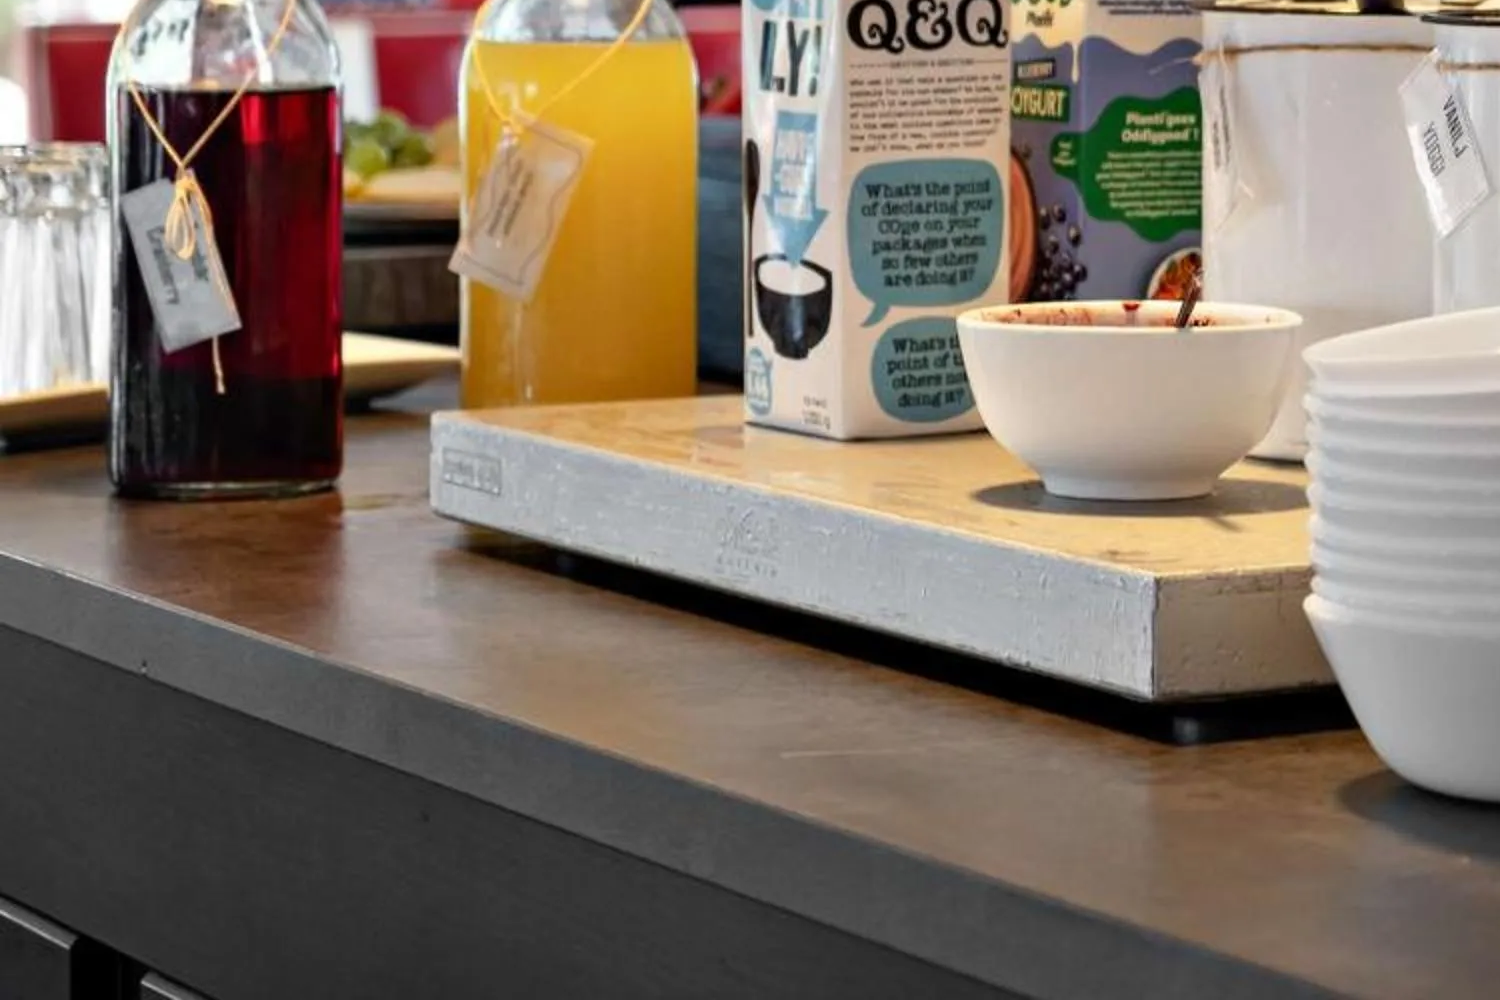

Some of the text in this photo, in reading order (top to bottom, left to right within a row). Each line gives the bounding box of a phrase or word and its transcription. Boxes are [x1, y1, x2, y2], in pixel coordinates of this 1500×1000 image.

[865, 178, 990, 199] What's the point
[861, 198, 993, 217] of declaring your
[924, 219, 944, 232] on
[947, 216, 981, 233] your
[872, 233, 987, 256] packages when
[882, 251, 978, 270] so few others
[884, 273, 912, 288] are
[915, 270, 957, 287] doing
[892, 337, 945, 354] What's
[886, 356, 929, 375] point
[933, 351, 949, 368] of
[891, 373, 942, 389] others
[898, 391, 942, 408] doing
